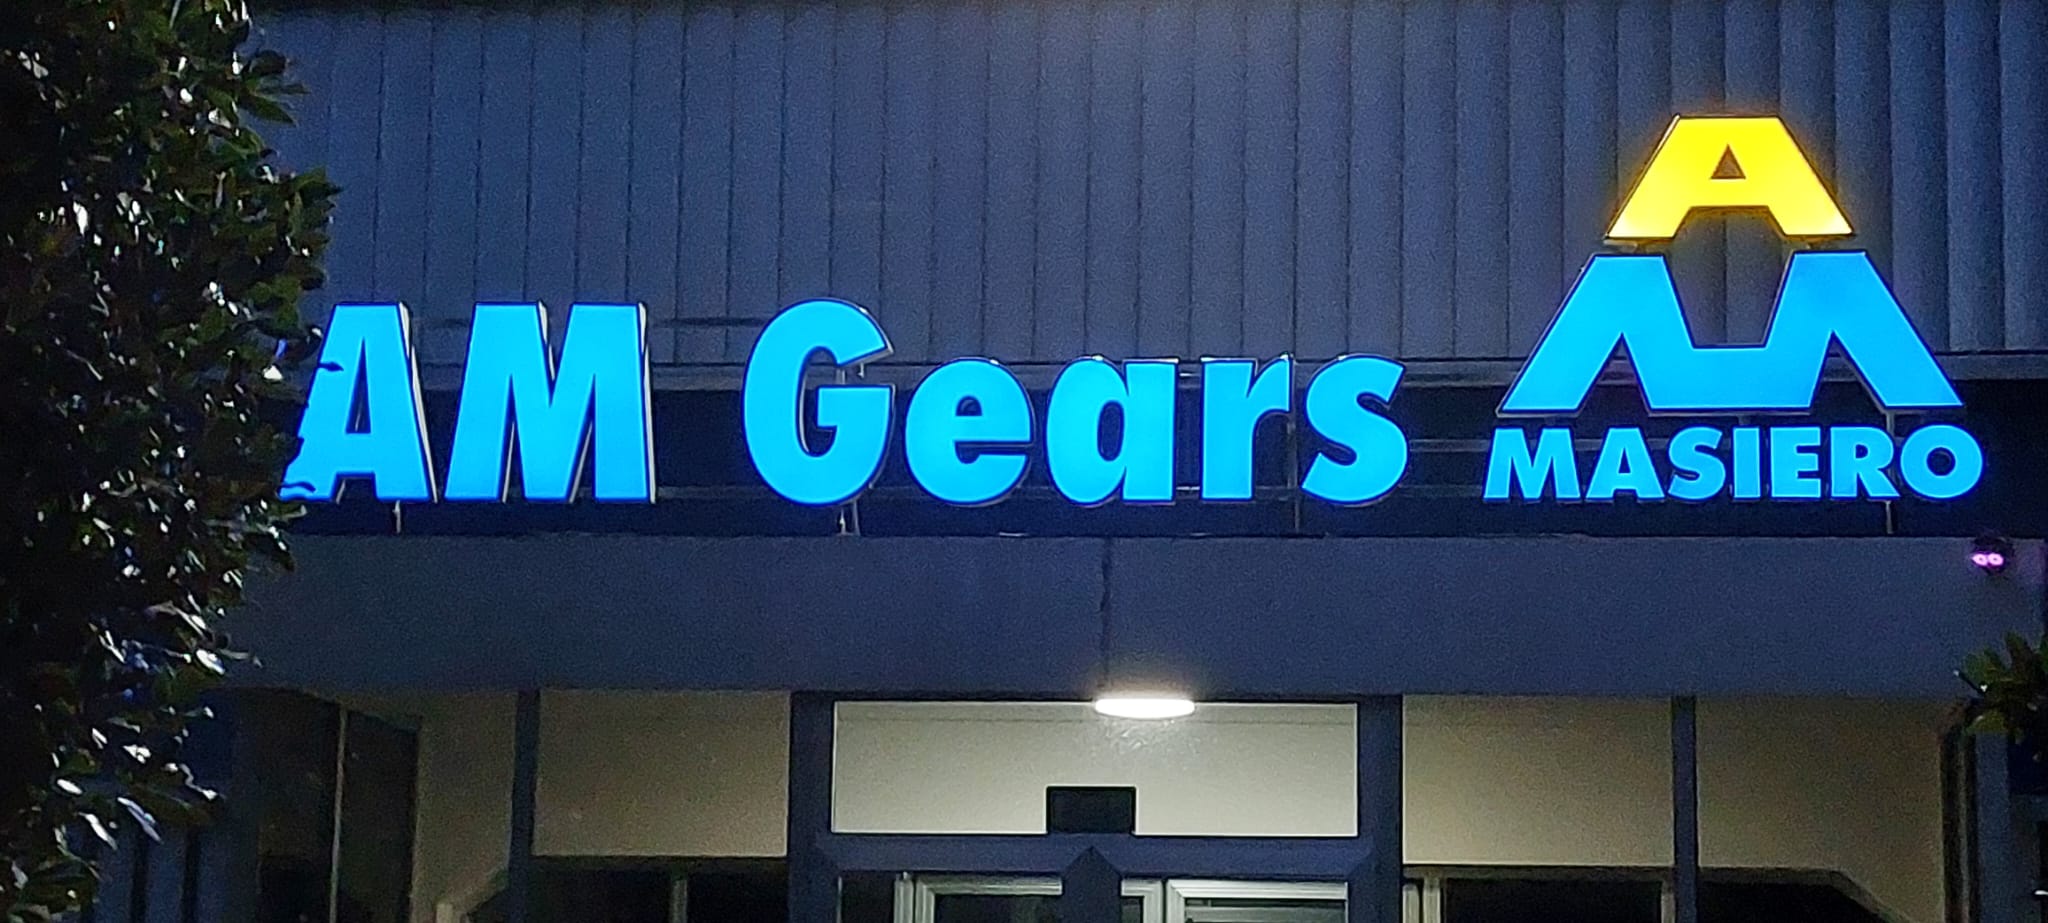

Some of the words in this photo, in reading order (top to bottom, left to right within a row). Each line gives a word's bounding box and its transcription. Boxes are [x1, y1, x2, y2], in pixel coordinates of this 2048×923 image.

[1606, 115, 1853, 238] A
[280, 302, 650, 501] AM
[742, 299, 1409, 504] Gears
[1483, 424, 1984, 501] MASIERO
